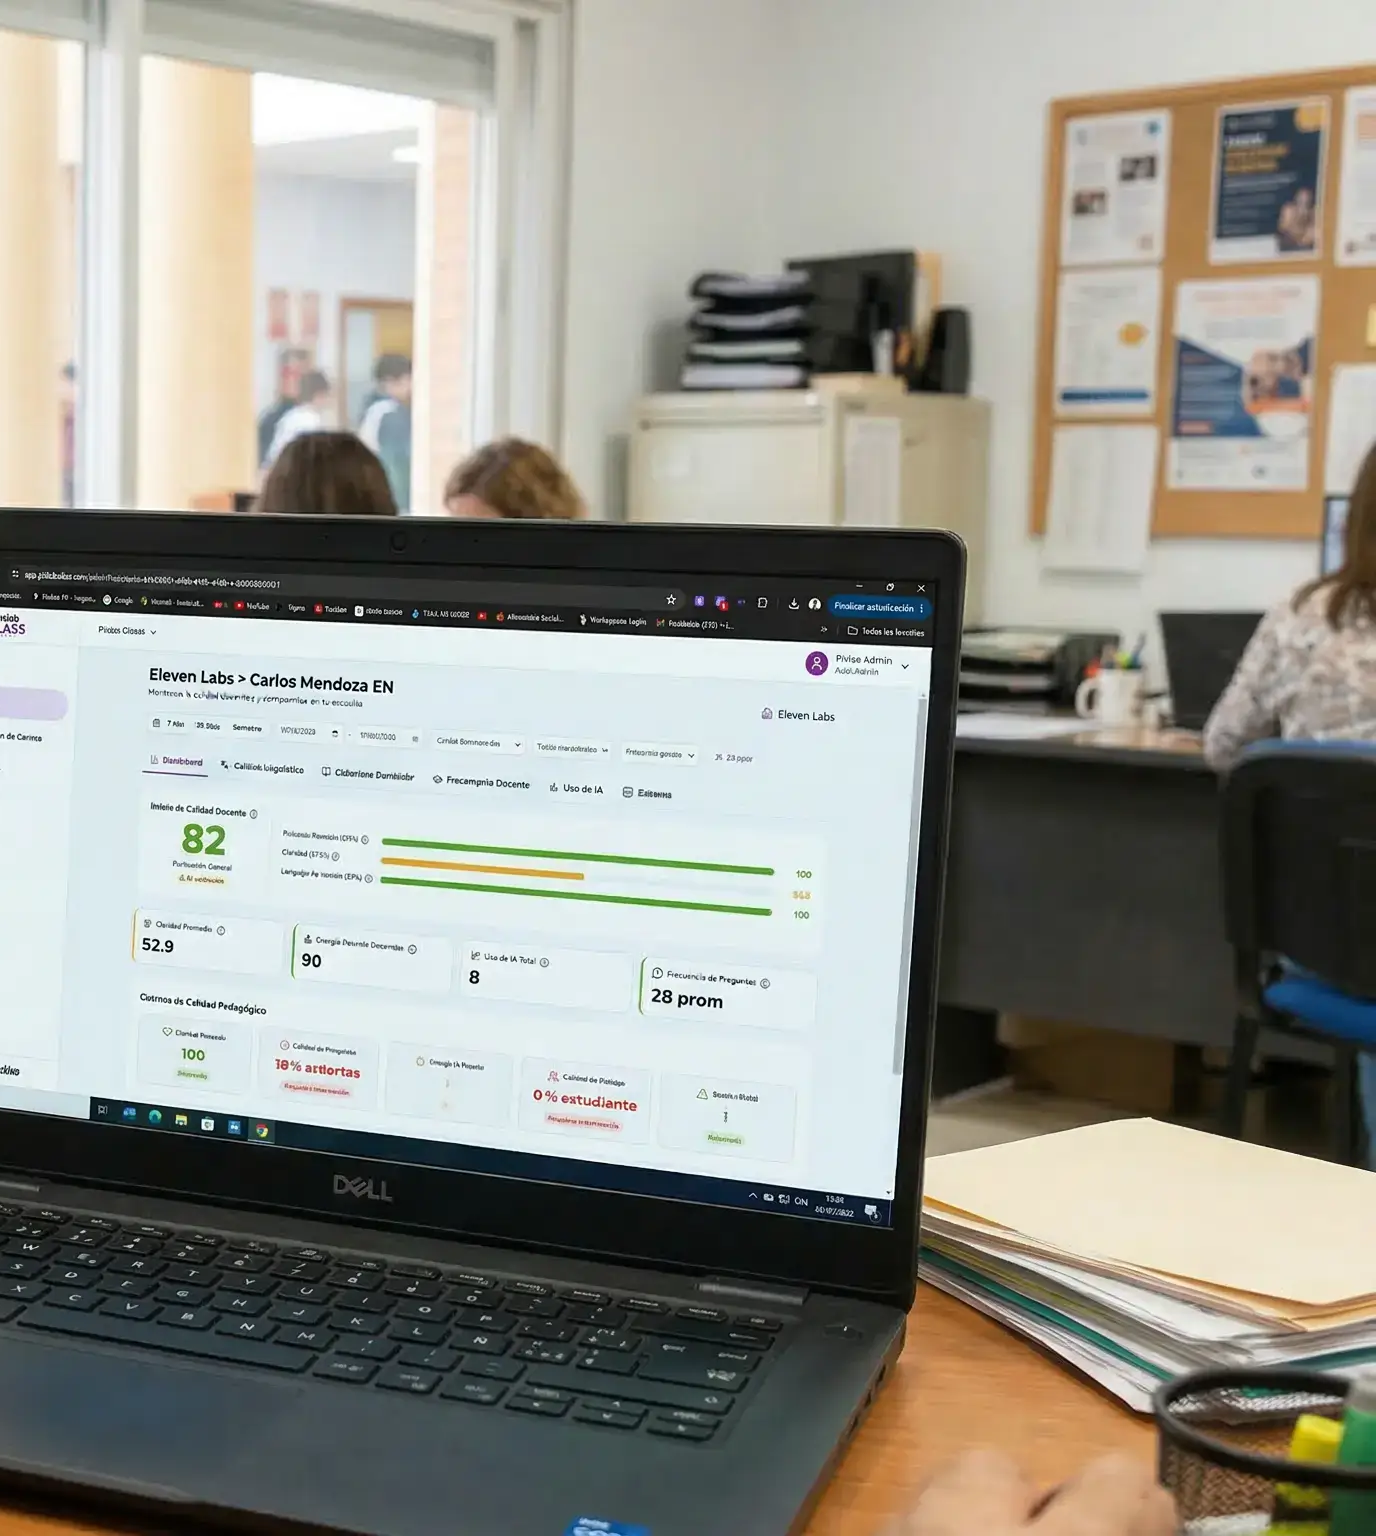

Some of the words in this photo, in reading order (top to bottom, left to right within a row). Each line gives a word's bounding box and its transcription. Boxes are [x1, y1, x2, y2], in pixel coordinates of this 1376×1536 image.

[149, 668, 196, 683] Eleven
[200, 670, 234, 685] Labs
[250, 672, 296, 689] Carlos
[300, 676, 368, 693] Mendoza
[372, 680, 394, 694] EN
[778, 710, 810, 721] Eleven
[812, 711, 836, 722] Labs
[496, 779, 530, 790] Docente
[563, 784, 580, 794] Uso
[581, 784, 592, 794] de
[216, 807, 246, 817] Docente
[182, 822, 226, 856] 82
[796, 870, 812, 878] 100
[794, 910, 810, 920] 100
[142, 938, 174, 954] 52.9
[301, 952, 322, 968] 90
[499, 954, 508, 962] de
[468, 970, 480, 984] 8
[708, 974, 717, 982] de
[651, 988, 673, 1004] 28
[677, 993, 723, 1008] prom
[181, 1048, 206, 1062] 100
[333, 1174, 393, 1202] DELL
